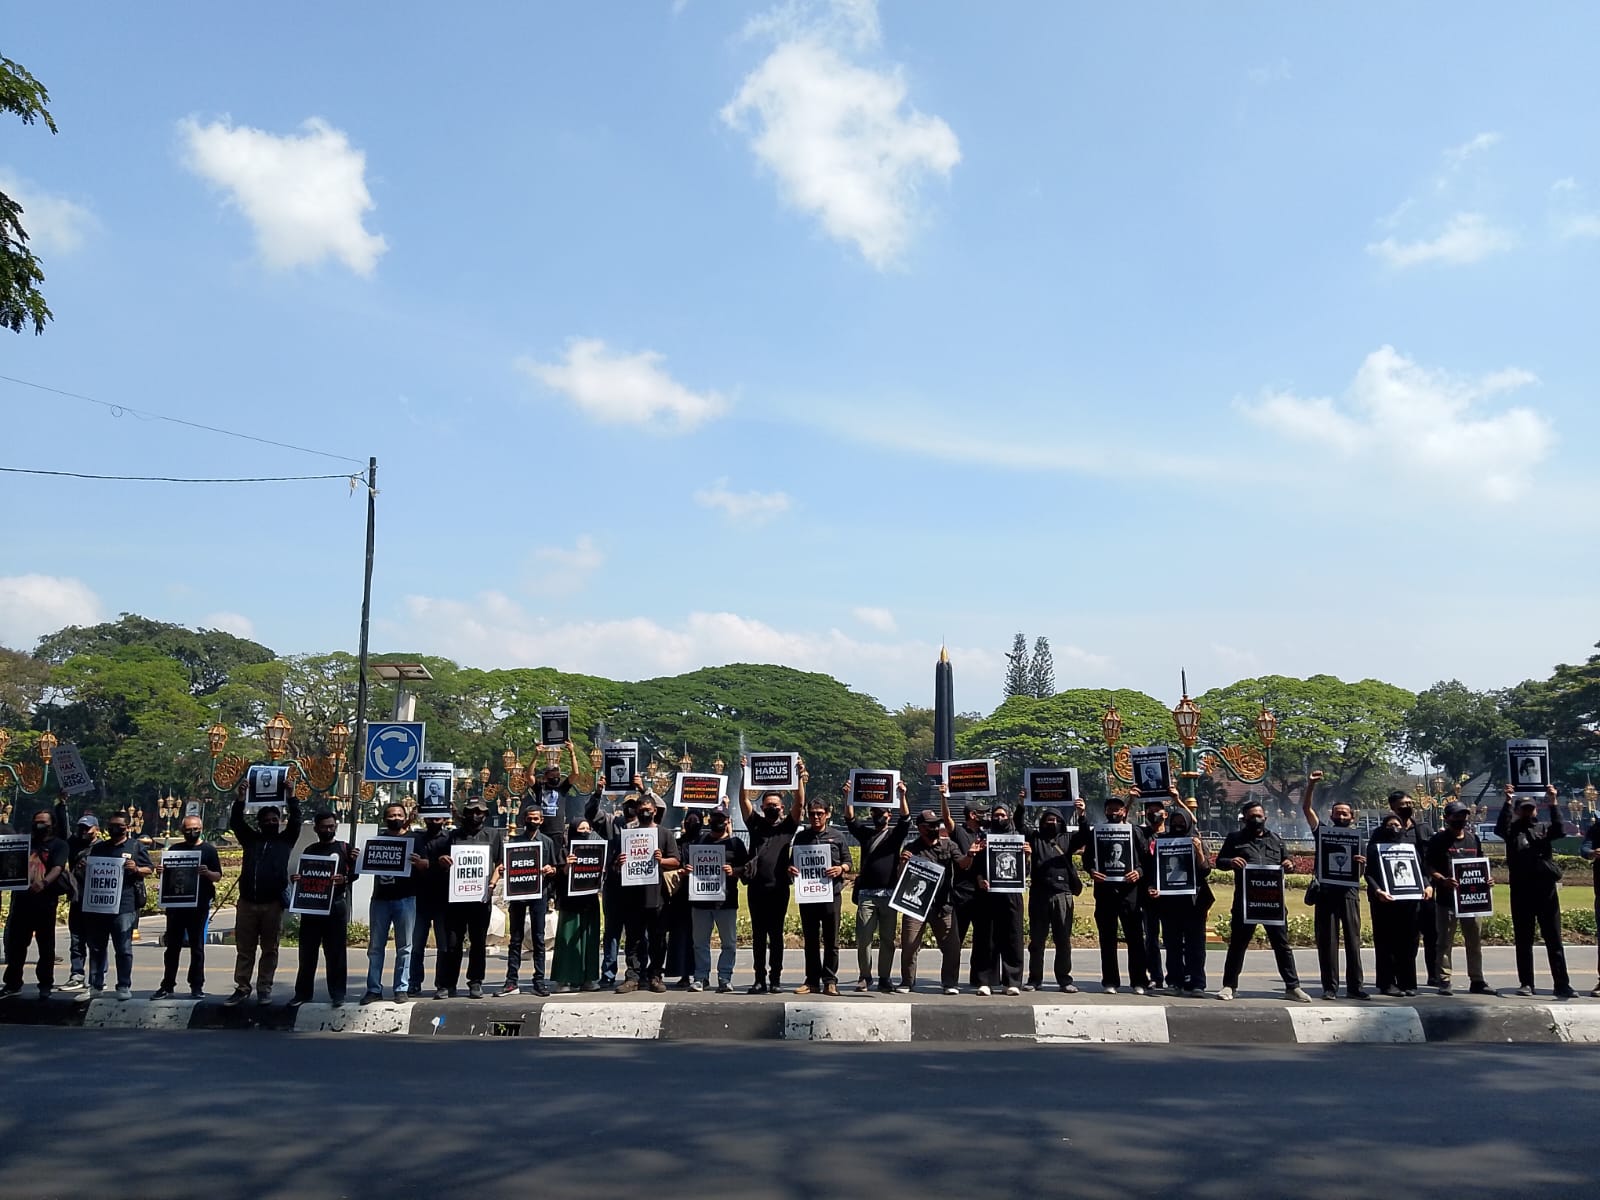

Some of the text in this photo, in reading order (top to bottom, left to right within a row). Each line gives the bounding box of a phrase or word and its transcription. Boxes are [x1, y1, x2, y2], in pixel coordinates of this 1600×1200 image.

[755, 767, 789, 775] HARUS
[367, 850, 402, 860] HARUS
[630, 847, 650, 856] HAK
[458, 855, 484, 866] LONDO
[511, 859, 536, 868] PERS
[577, 857, 599, 865] PERS
[697, 855, 720, 863] KAMI
[800, 855, 826, 867] LONDO
[627, 860, 655, 869] LONDO
[93, 867, 116, 876] KAMI
[302, 869, 331, 878] LAWAN
[457, 866, 484, 879] IRENG
[628, 867, 655, 877] IRENG
[695, 864, 721, 876] IRENG
[1462, 870, 1481, 878] ANTI
[510, 875, 538, 883] RAKYAT
[574, 872, 599, 880] RAKYAT
[90, 877, 118, 889] IRENG
[1459, 877, 1486, 885] KRITIK
[458, 884, 484, 892] PERS
[696, 882, 721, 892] LONDO
[803, 885, 828, 893] PERS
[90, 894, 115, 905] LONDO
[298, 892, 329, 900] JURNALIS
[1460, 893, 1488, 901] TAKUT
